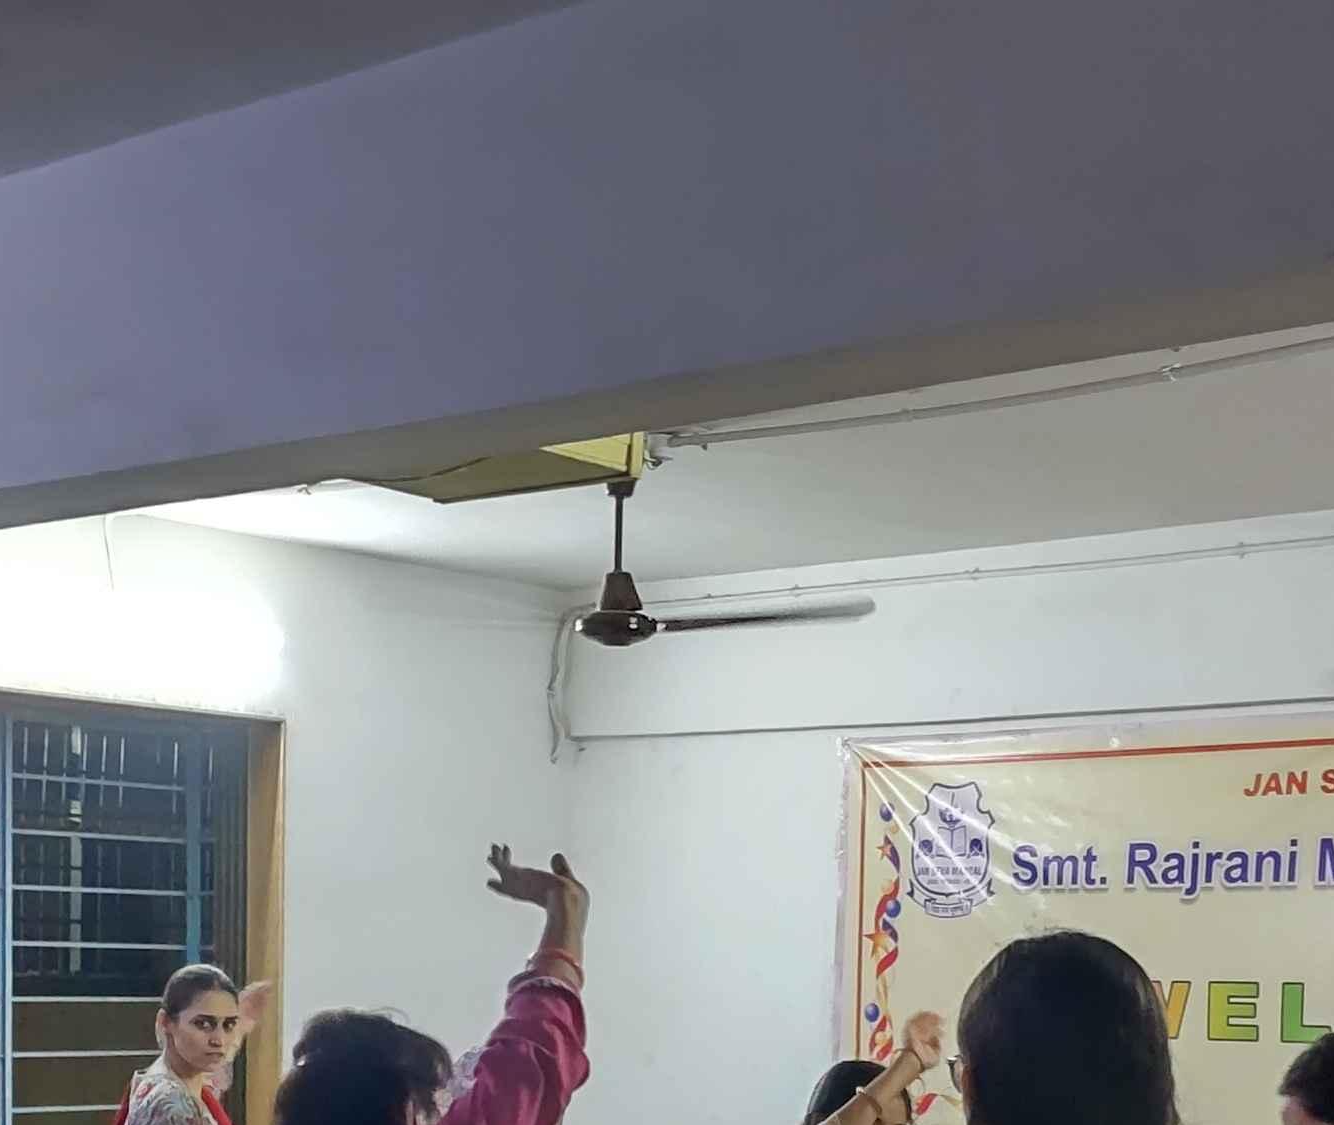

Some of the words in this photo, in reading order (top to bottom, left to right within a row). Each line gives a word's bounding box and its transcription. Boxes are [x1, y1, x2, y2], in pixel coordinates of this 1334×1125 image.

[1243, 770, 1308, 797] JAN
[1011, 845, 1108, 887] Smt.
[1126, 840, 1299, 896] Rajrani
